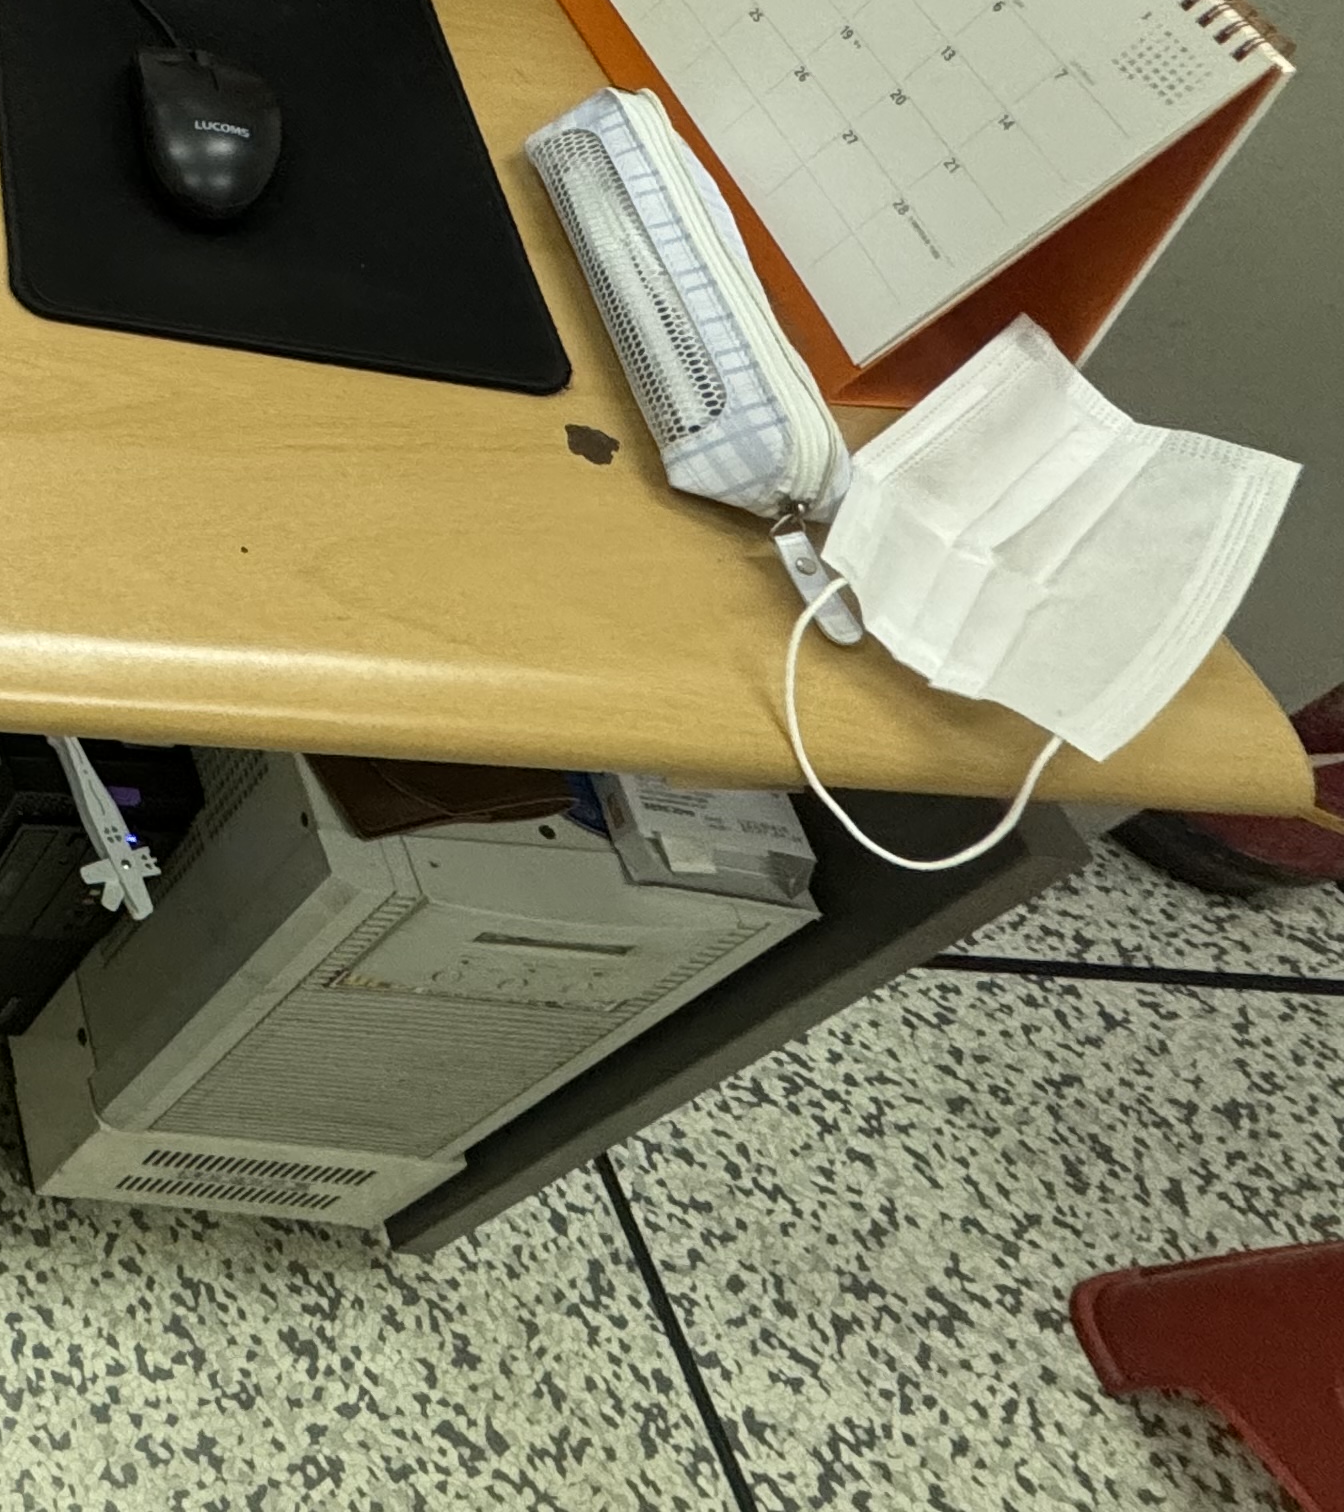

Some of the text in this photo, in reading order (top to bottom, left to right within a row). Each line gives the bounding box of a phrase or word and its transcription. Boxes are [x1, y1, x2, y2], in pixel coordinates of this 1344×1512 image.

[992, 0, 1006, 13] 6
[749, 8, 764, 22] 25
[840, 25, 854, 40] 19
[940, 45, 957, 62] 13
[794, 66, 810, 82] 26
[1054, 68, 1069, 80] 7
[889, 88, 907, 106] 20
[194, 120, 250, 138] LUCOMS
[998, 114, 1015, 131] 14
[842, 129, 859, 145] 27
[943, 157, 961, 174] 21
[892, 198, 910, 216] 28
